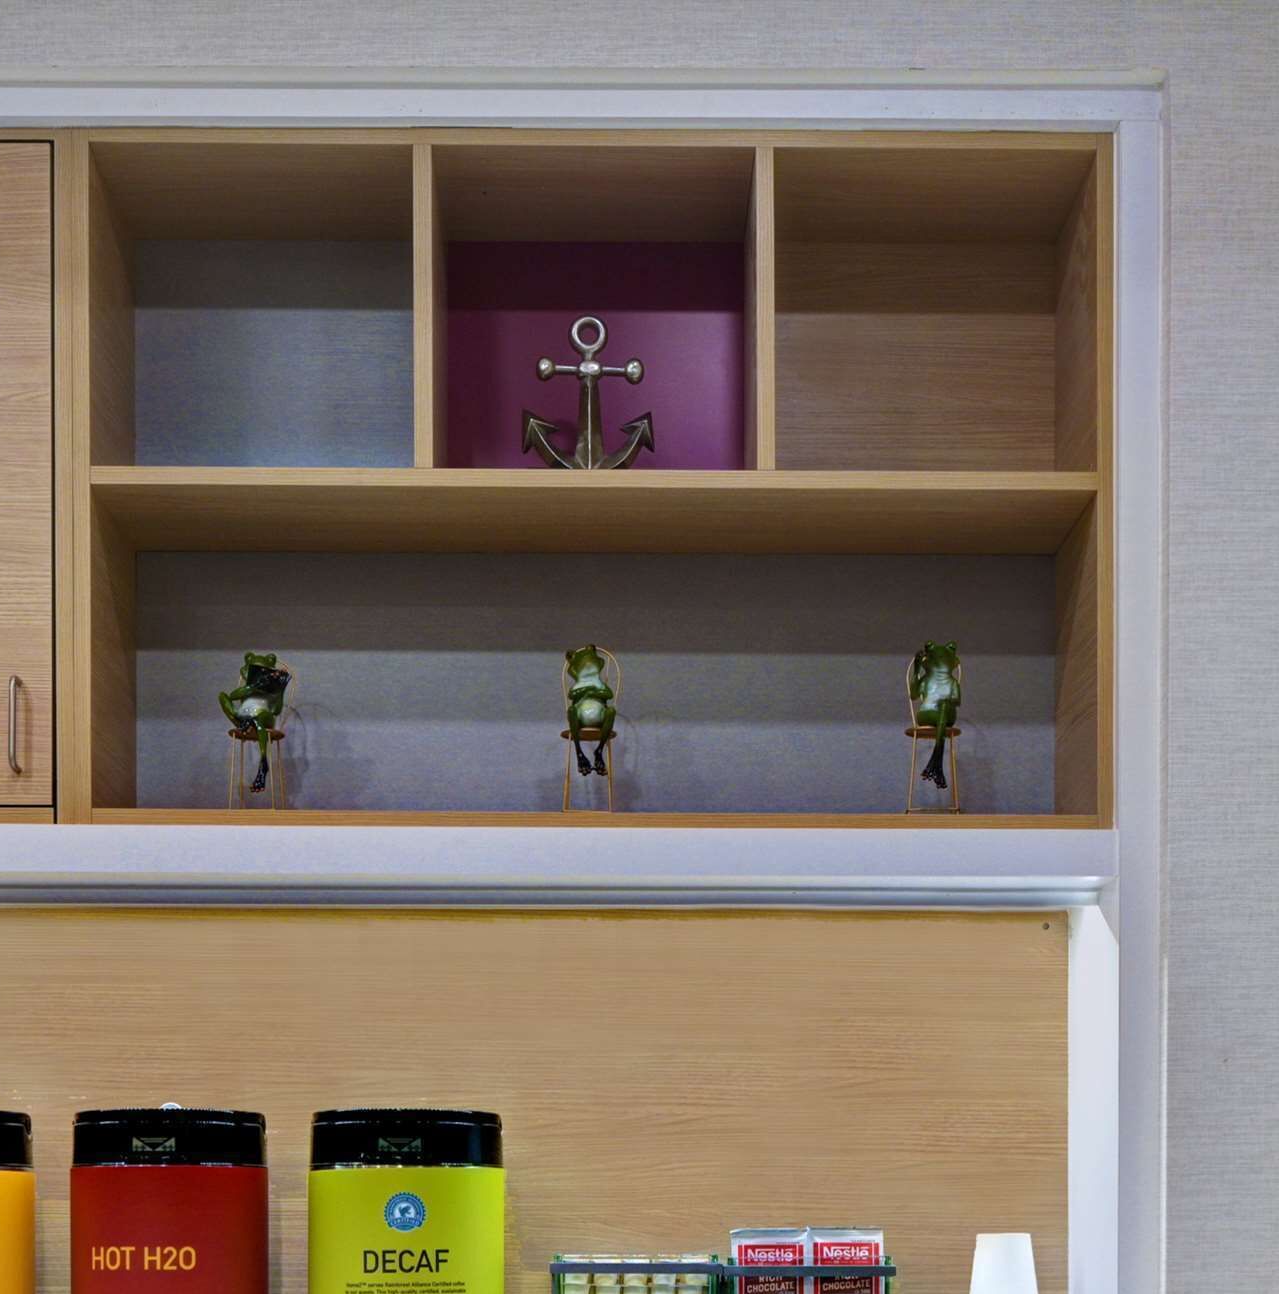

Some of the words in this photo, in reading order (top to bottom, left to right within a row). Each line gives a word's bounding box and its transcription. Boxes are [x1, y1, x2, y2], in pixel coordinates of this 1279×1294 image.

[92, 1246, 136, 1271] HOT
[363, 1248, 450, 1274] DECAF
[746, 1281, 795, 1294] CHOCOLATE
[822, 1279, 871, 1291] CHOCOLATE
